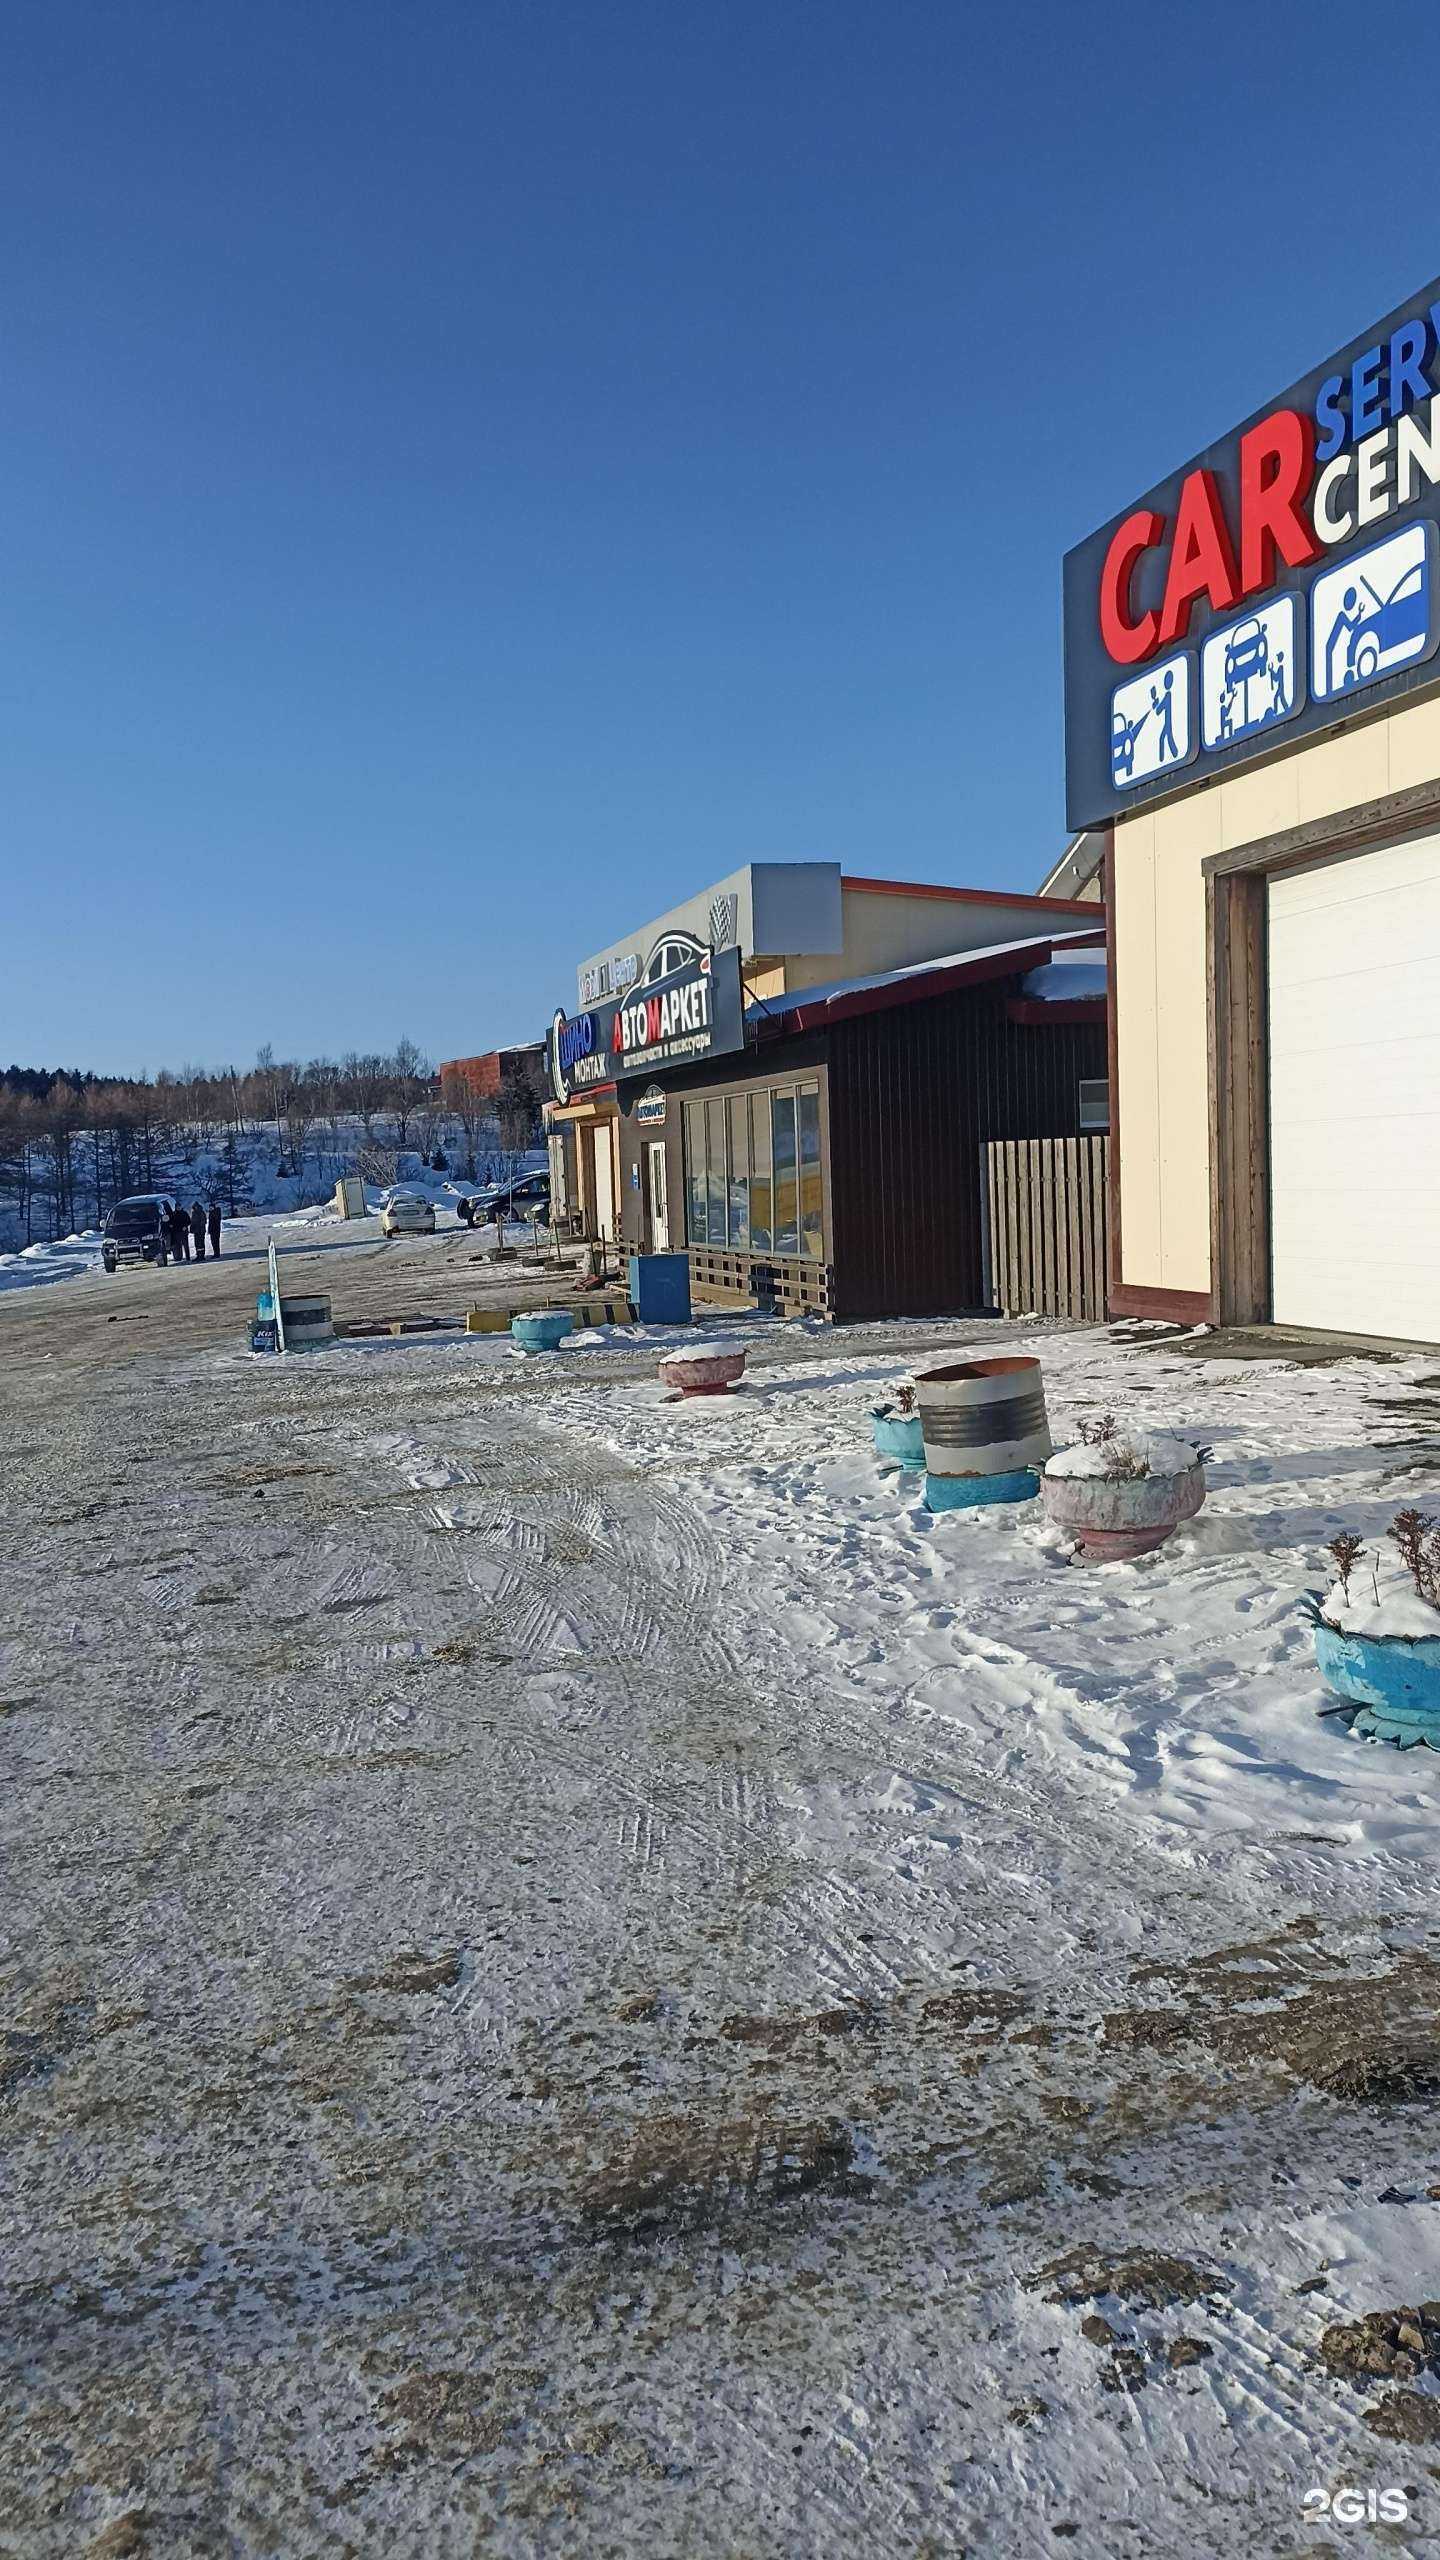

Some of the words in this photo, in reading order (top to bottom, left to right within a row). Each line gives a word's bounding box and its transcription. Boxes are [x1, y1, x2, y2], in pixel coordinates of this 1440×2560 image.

[1316, 301, 1440, 462] SER
[1100, 410, 1316, 664] CAR
[1314, 392, 1440, 544] CEN
[574, 1052, 607, 1083] МОНТАЖ
[612, 977, 708, 1055] АВТОМАРКЕТ
